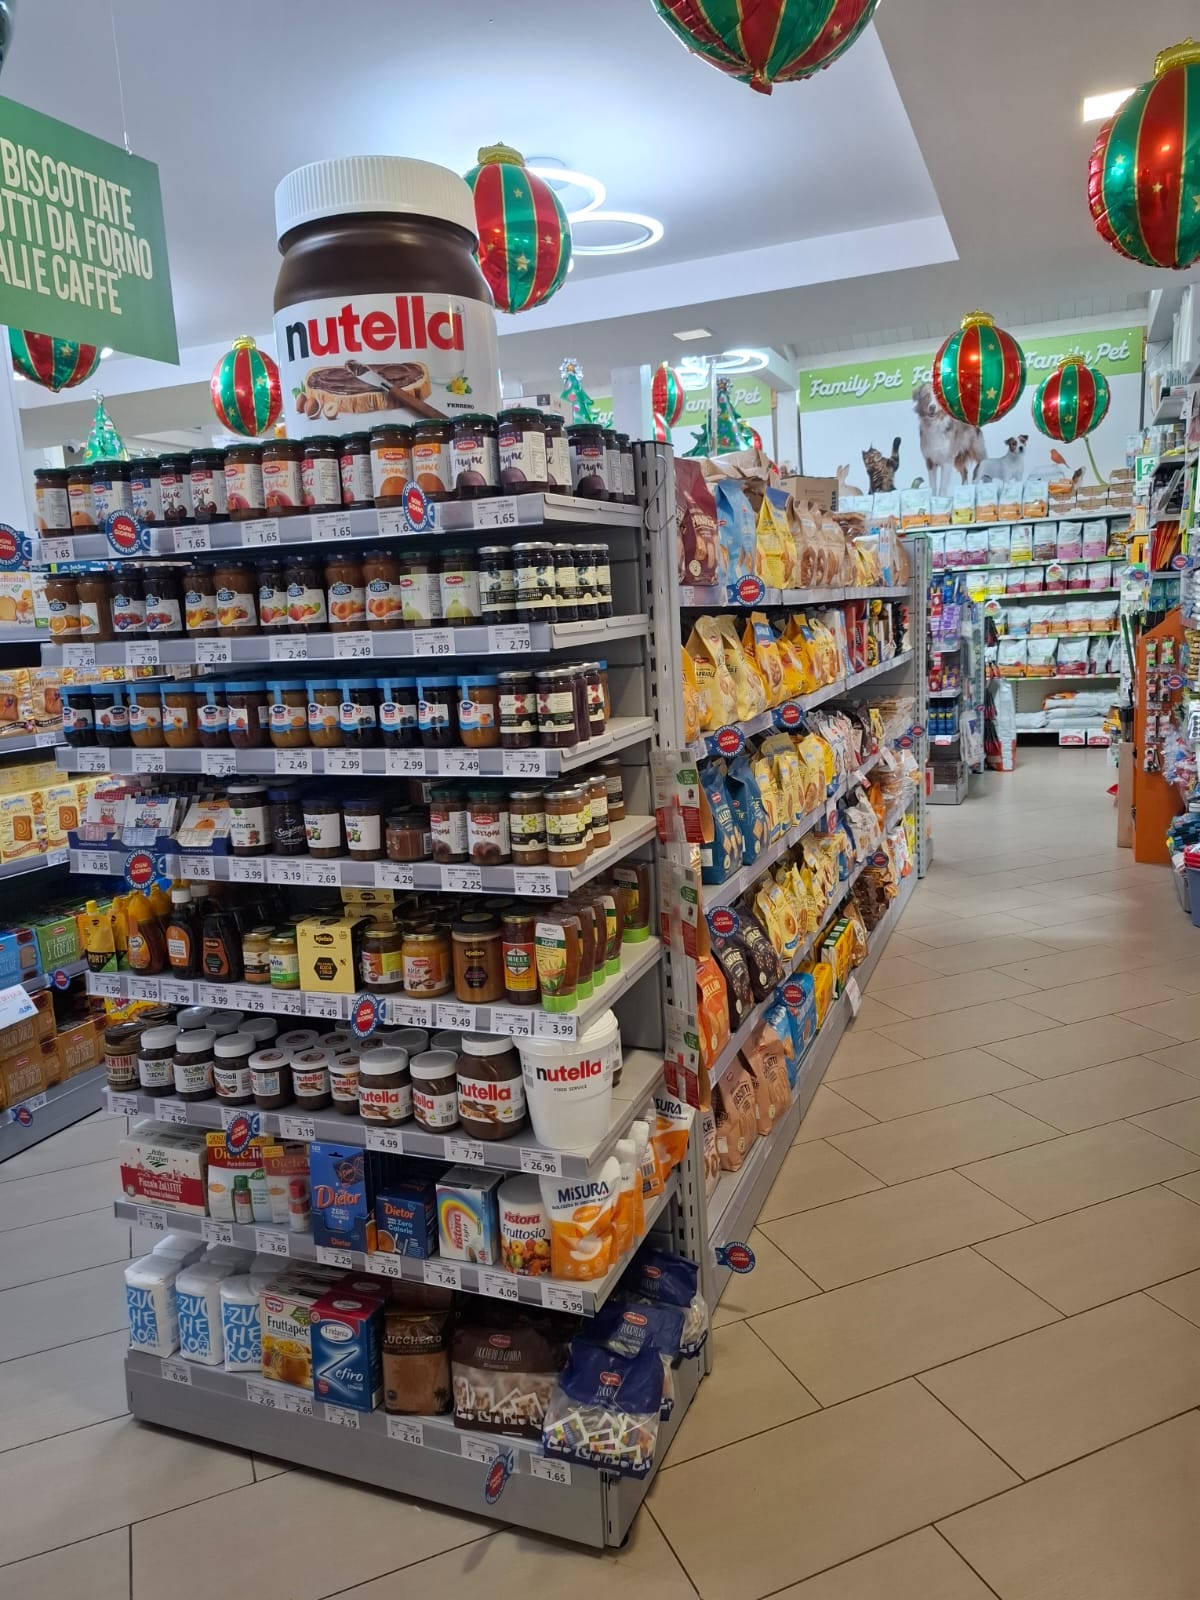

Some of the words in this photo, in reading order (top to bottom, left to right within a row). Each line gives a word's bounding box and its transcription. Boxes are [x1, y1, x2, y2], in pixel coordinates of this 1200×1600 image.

[46, 204, 82, 258] DA
[83, 217, 153, 280] FORNO
[34, 248, 51, 295] E
[285, 295, 464, 362] nutella
[1095, 340, 1130, 363] Pet
[810, 374, 871, 398] Family
[872, 369, 904, 389] Pet
[446, 402, 475, 410] FERRERO
[734, 388, 762, 407] Pet
[394, 523, 411, 533] 1,6
[552, 1024, 573, 1035] 3,99
[536, 1059, 602, 1082] nutella
[456, 1080, 511, 1101] nutella
[531, 1161, 556, 1173] 26,90
[314, 1185, 361, 1210] Dietor
[384, 1202, 416, 1219] Dietor
[504, 1211, 541, 1224] ristora
[502, 1223, 546, 1240] Fruttosio
[266, 1315, 309, 1337] Fruttapec
